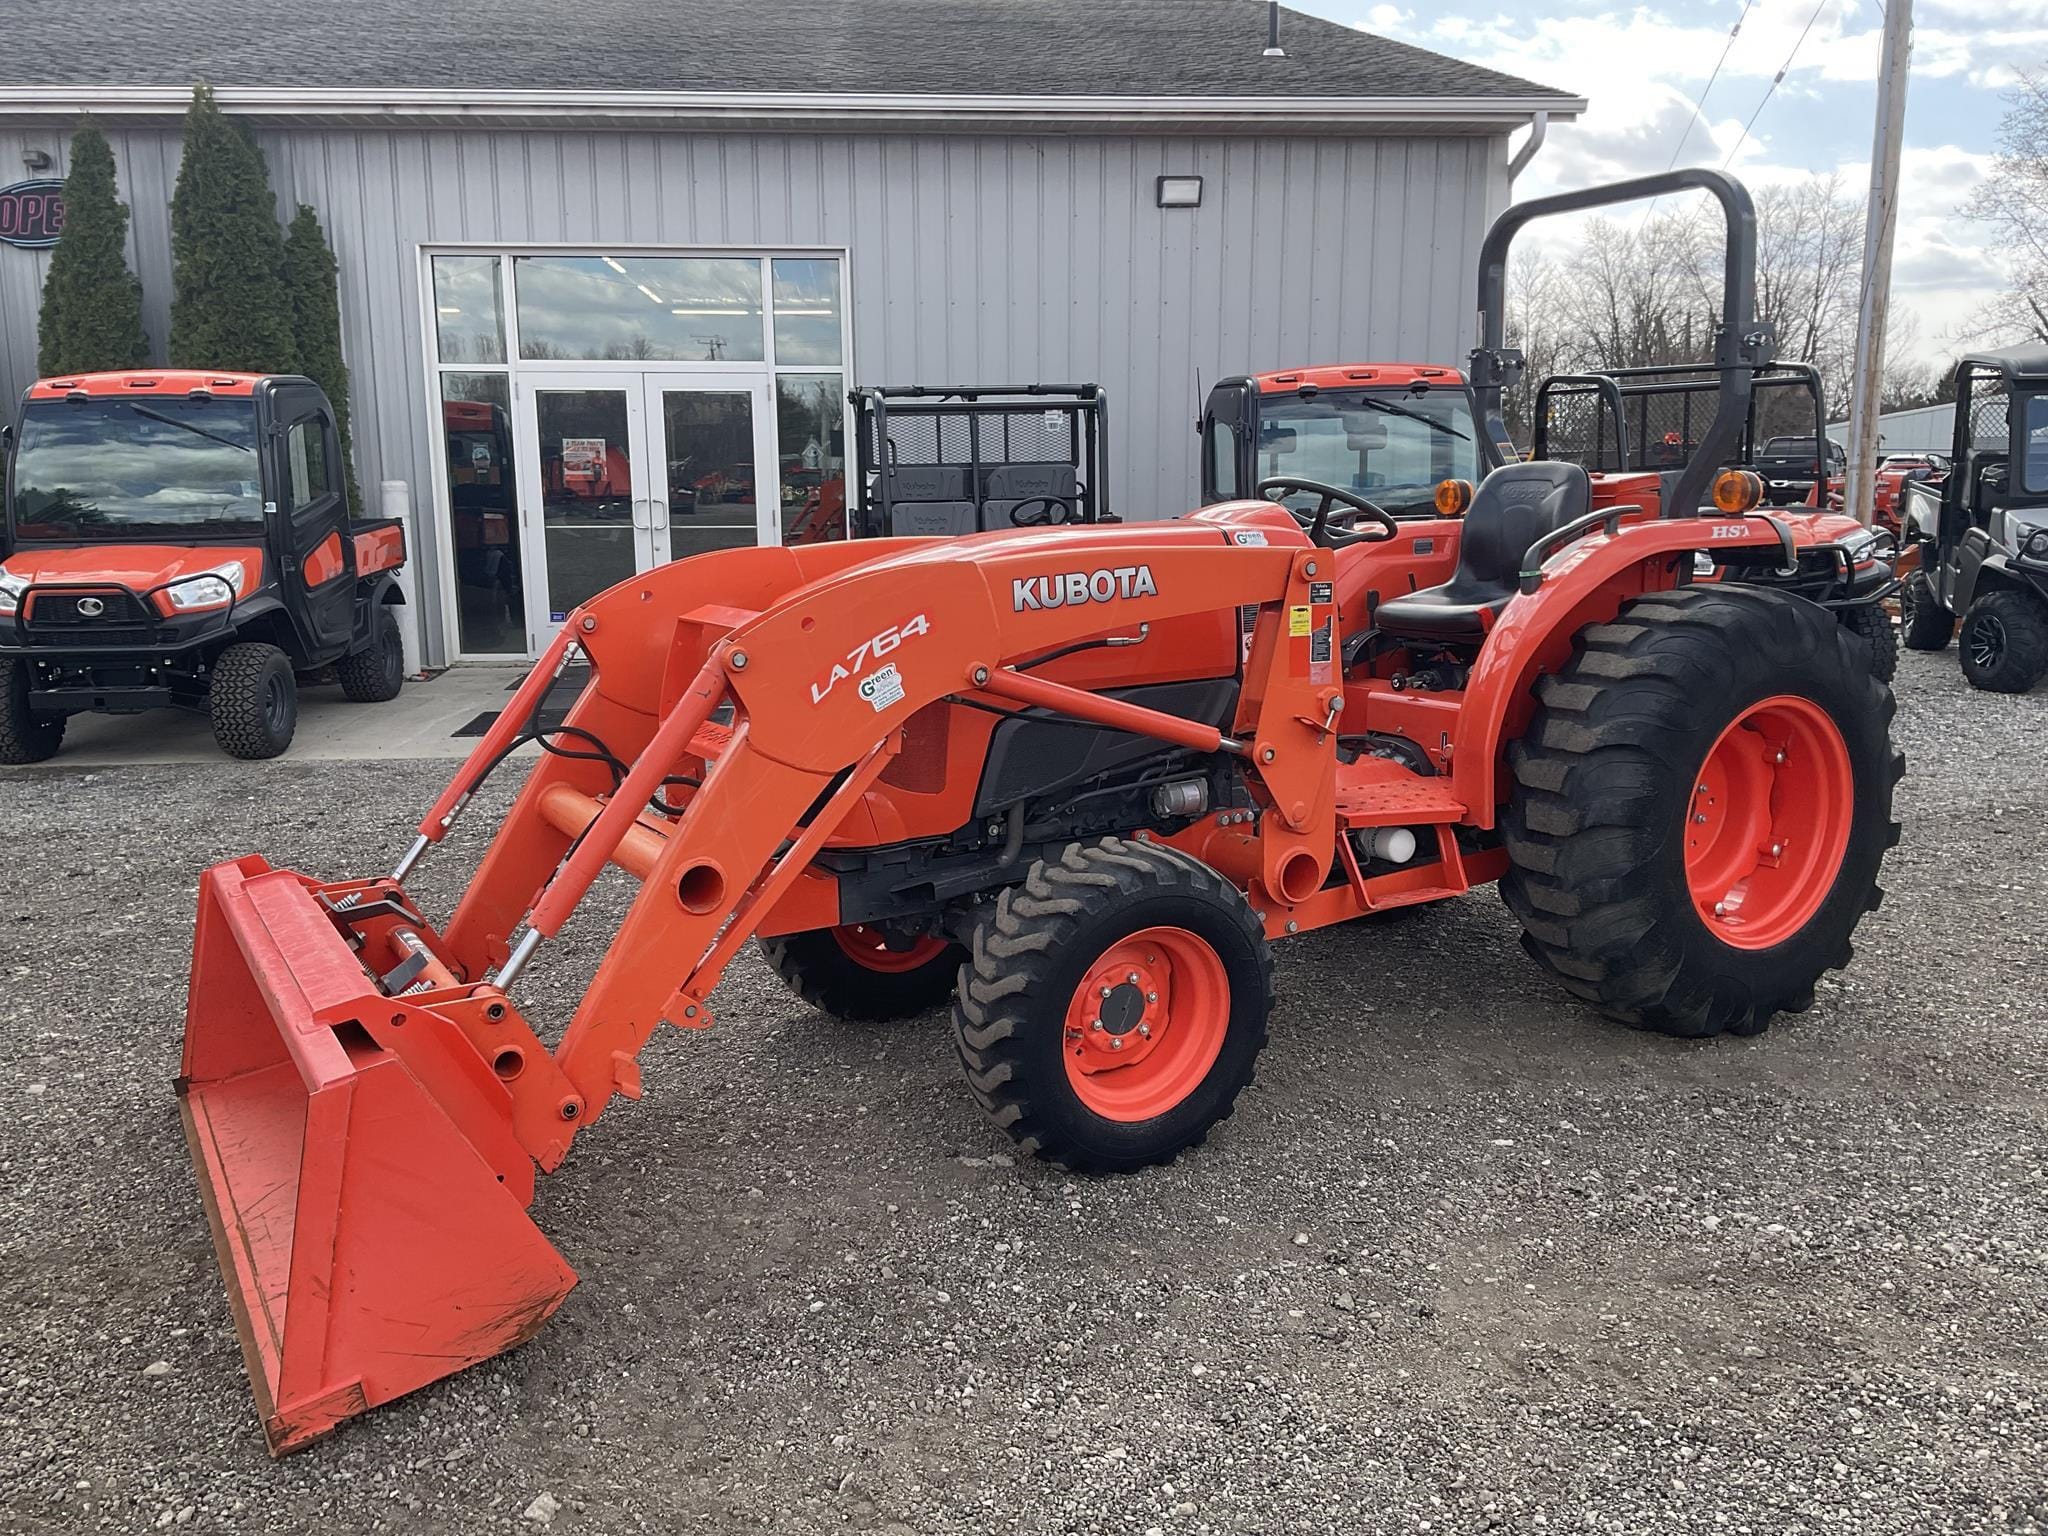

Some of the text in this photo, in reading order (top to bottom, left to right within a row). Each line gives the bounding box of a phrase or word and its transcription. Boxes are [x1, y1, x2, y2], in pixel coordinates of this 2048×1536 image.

[0, 194, 66, 235] OPE
[1013, 565, 1158, 612] KUBOTA
[811, 614, 931, 704] LA764
[861, 668, 894, 697] Green
